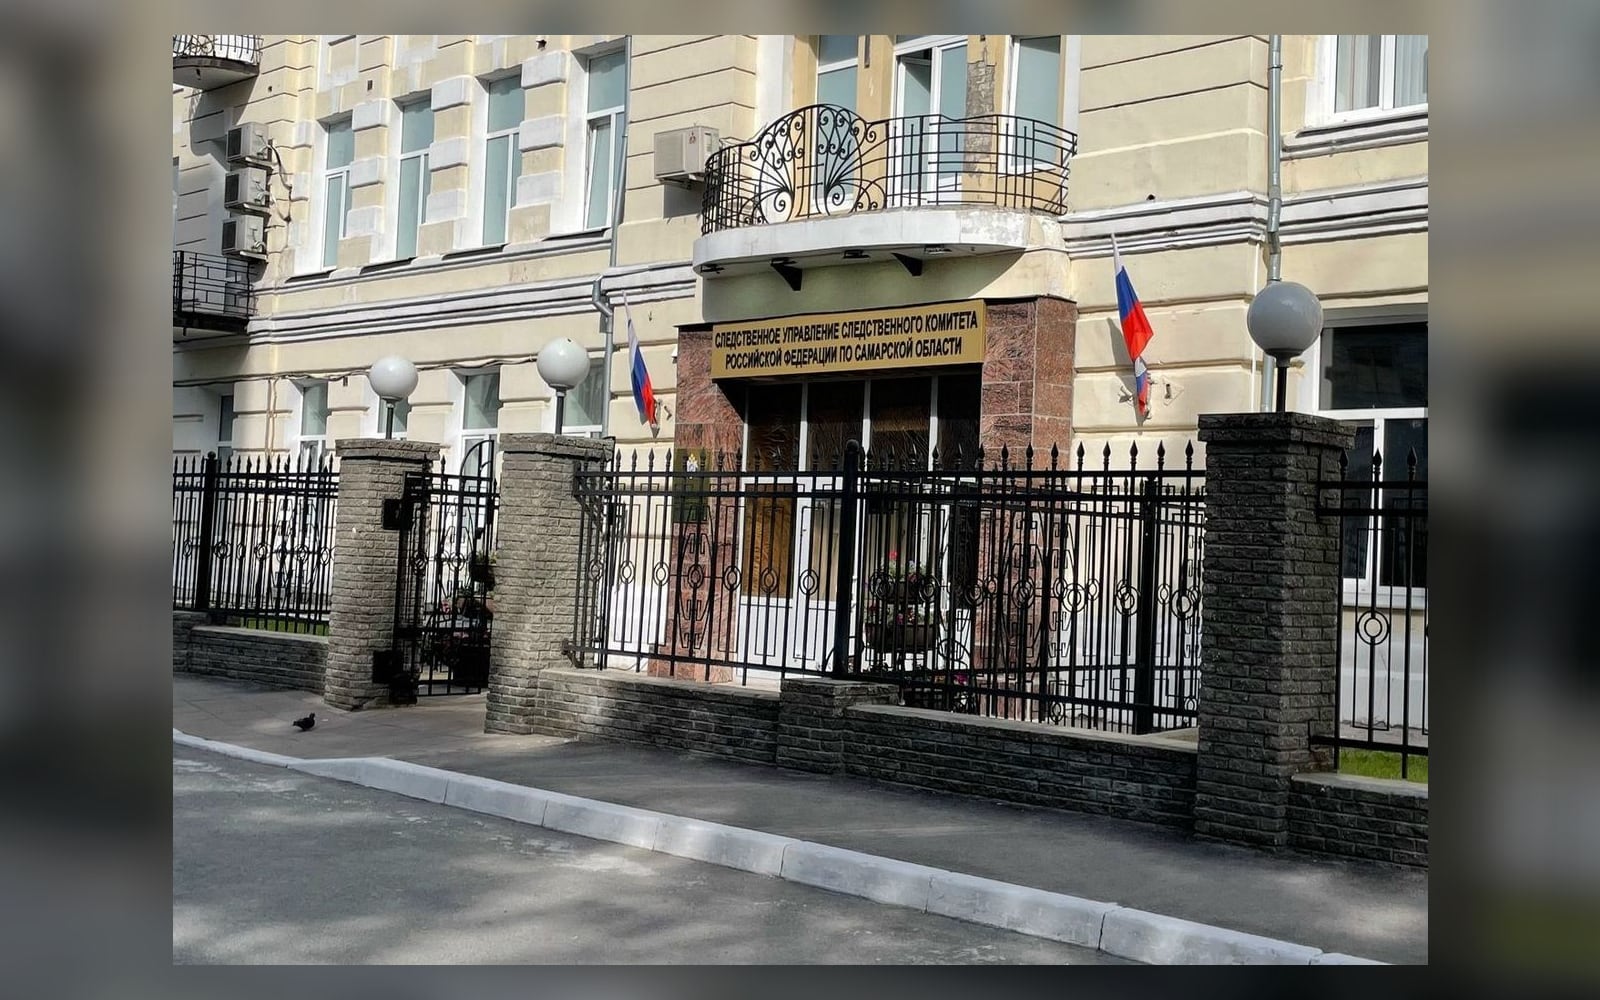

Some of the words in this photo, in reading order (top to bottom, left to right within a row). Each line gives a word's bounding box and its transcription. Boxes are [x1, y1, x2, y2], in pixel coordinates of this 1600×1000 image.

[715, 327, 780, 350] СЛЕДСТВЕННОЕ
[782, 322, 839, 343] УПРАВЛЕНИЕ
[841, 315, 923, 341] СЛЕДСТВЕННОГО
[925, 311, 978, 332] КОМИТЕТА
[725, 348, 782, 370] РОССИЙСКОЙ
[783, 345, 837, 369] ФЕДЕРАЦИИ
[839, 345, 852, 362] ПО
[854, 337, 913, 362] САМАРСКОЙ
[915, 337, 962, 357] ОБЛАСТИ
